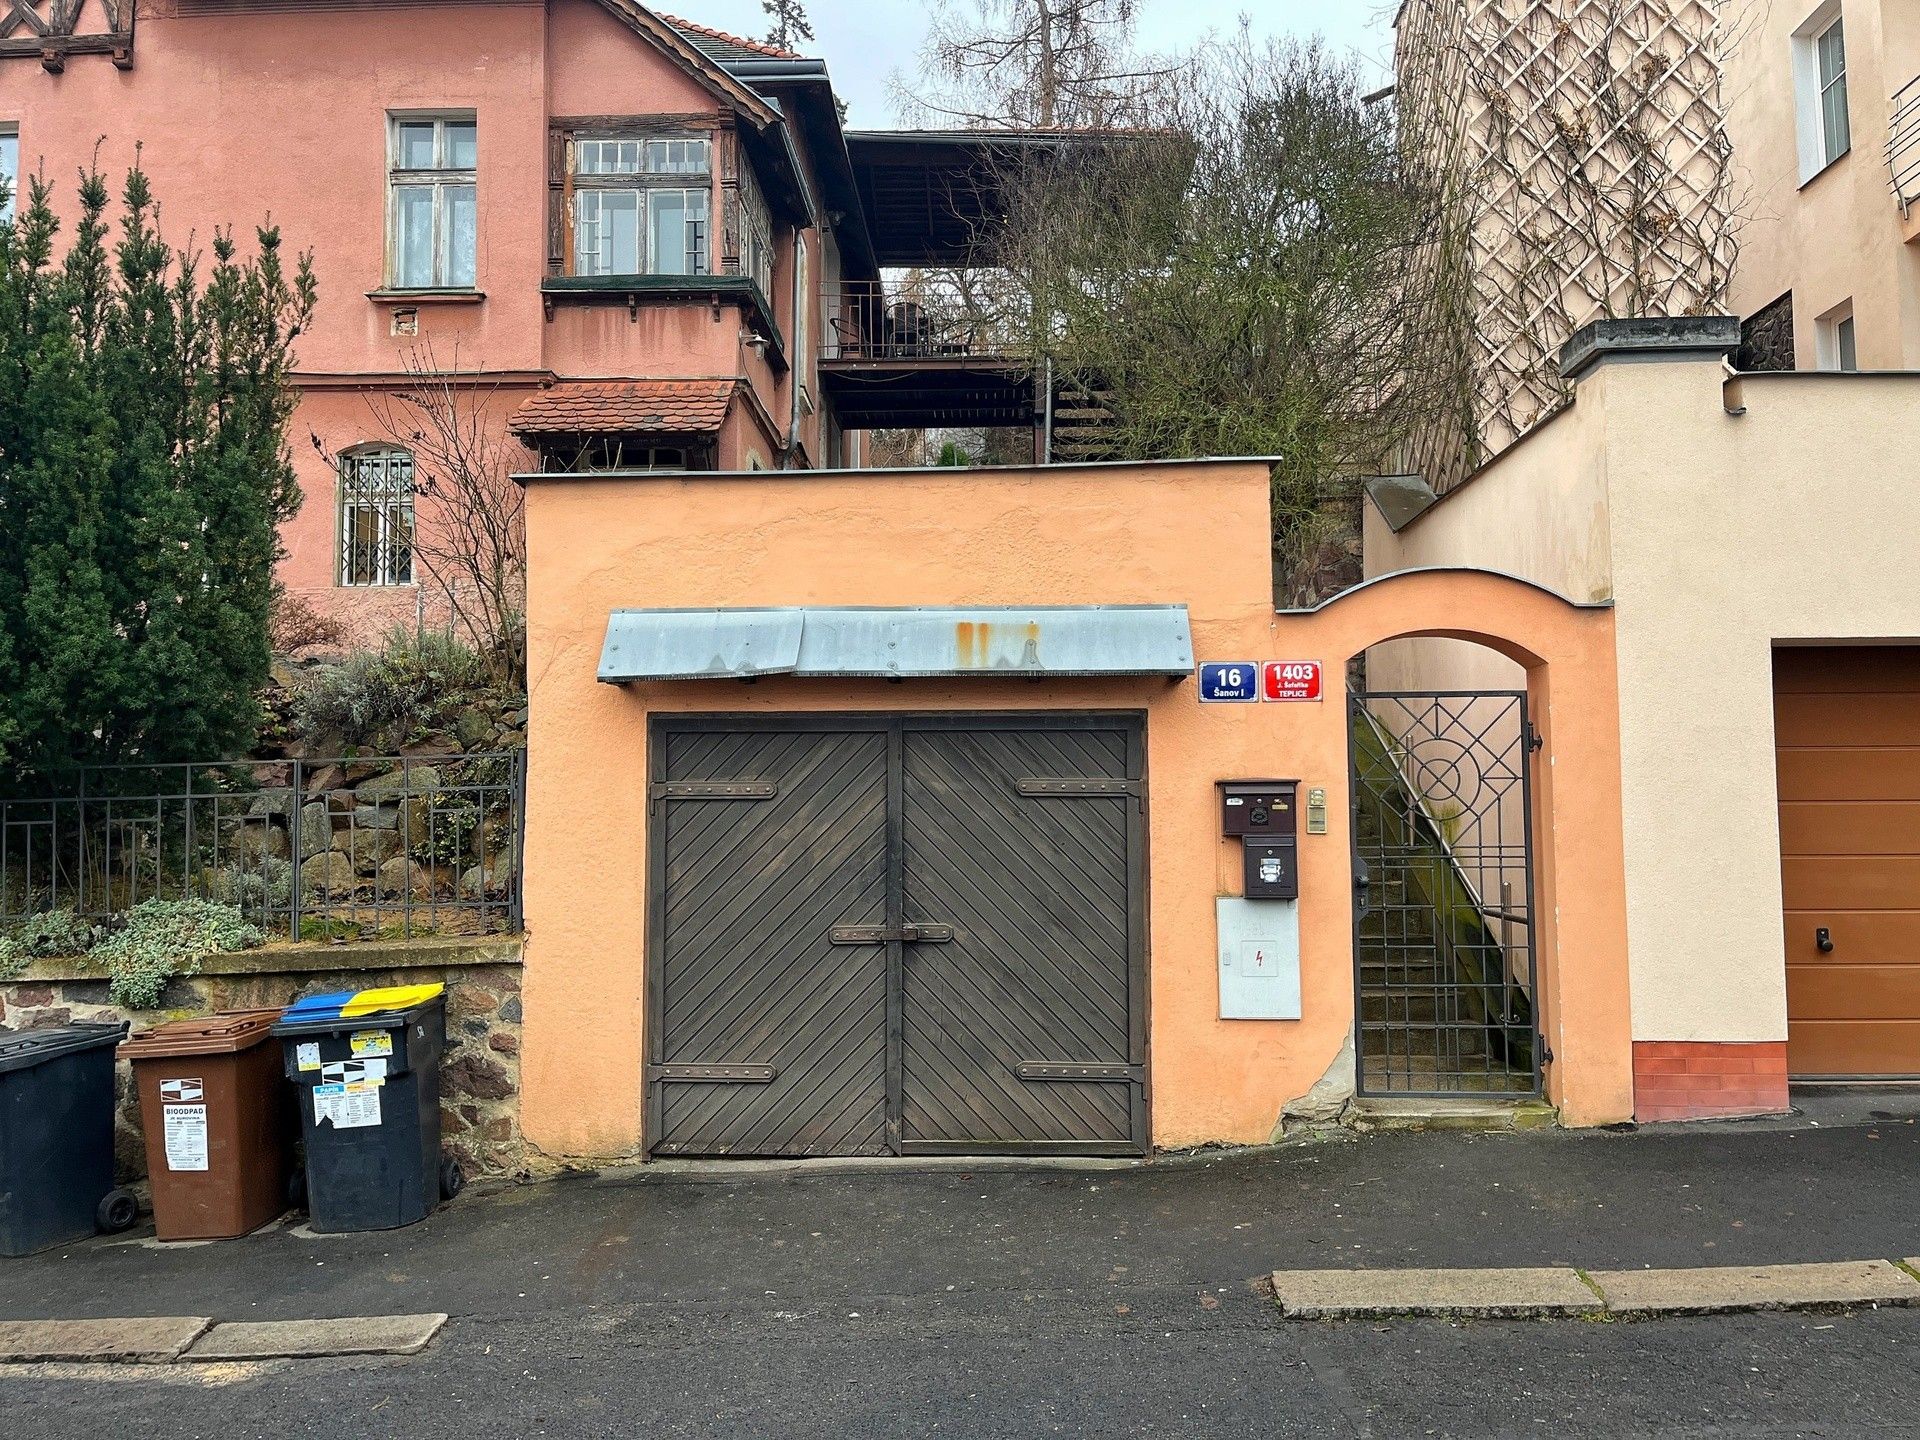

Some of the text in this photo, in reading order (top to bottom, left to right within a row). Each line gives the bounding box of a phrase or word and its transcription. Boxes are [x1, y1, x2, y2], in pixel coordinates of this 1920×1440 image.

[1217, 668, 1241, 687] 16
[1273, 665, 1313, 680] 1403
[1214, 687, 1239, 697] Šanov
